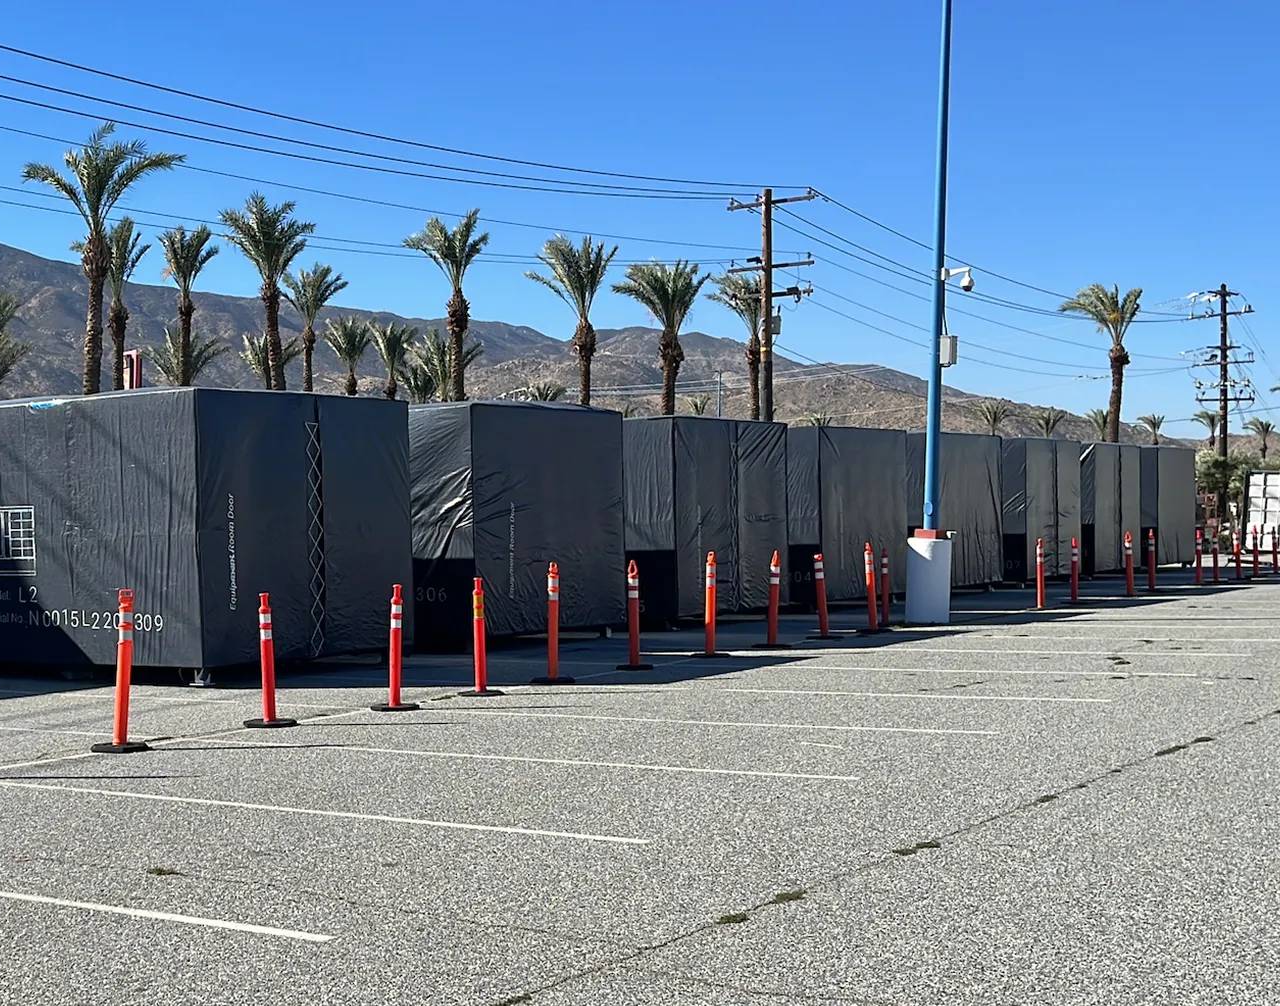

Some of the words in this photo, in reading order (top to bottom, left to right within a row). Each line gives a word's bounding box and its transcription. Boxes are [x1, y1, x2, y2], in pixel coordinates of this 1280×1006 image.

[227, 493, 235, 519] Door
[227, 521, 235, 553] Room
[28, 608, 164, 632] N0015L220309
